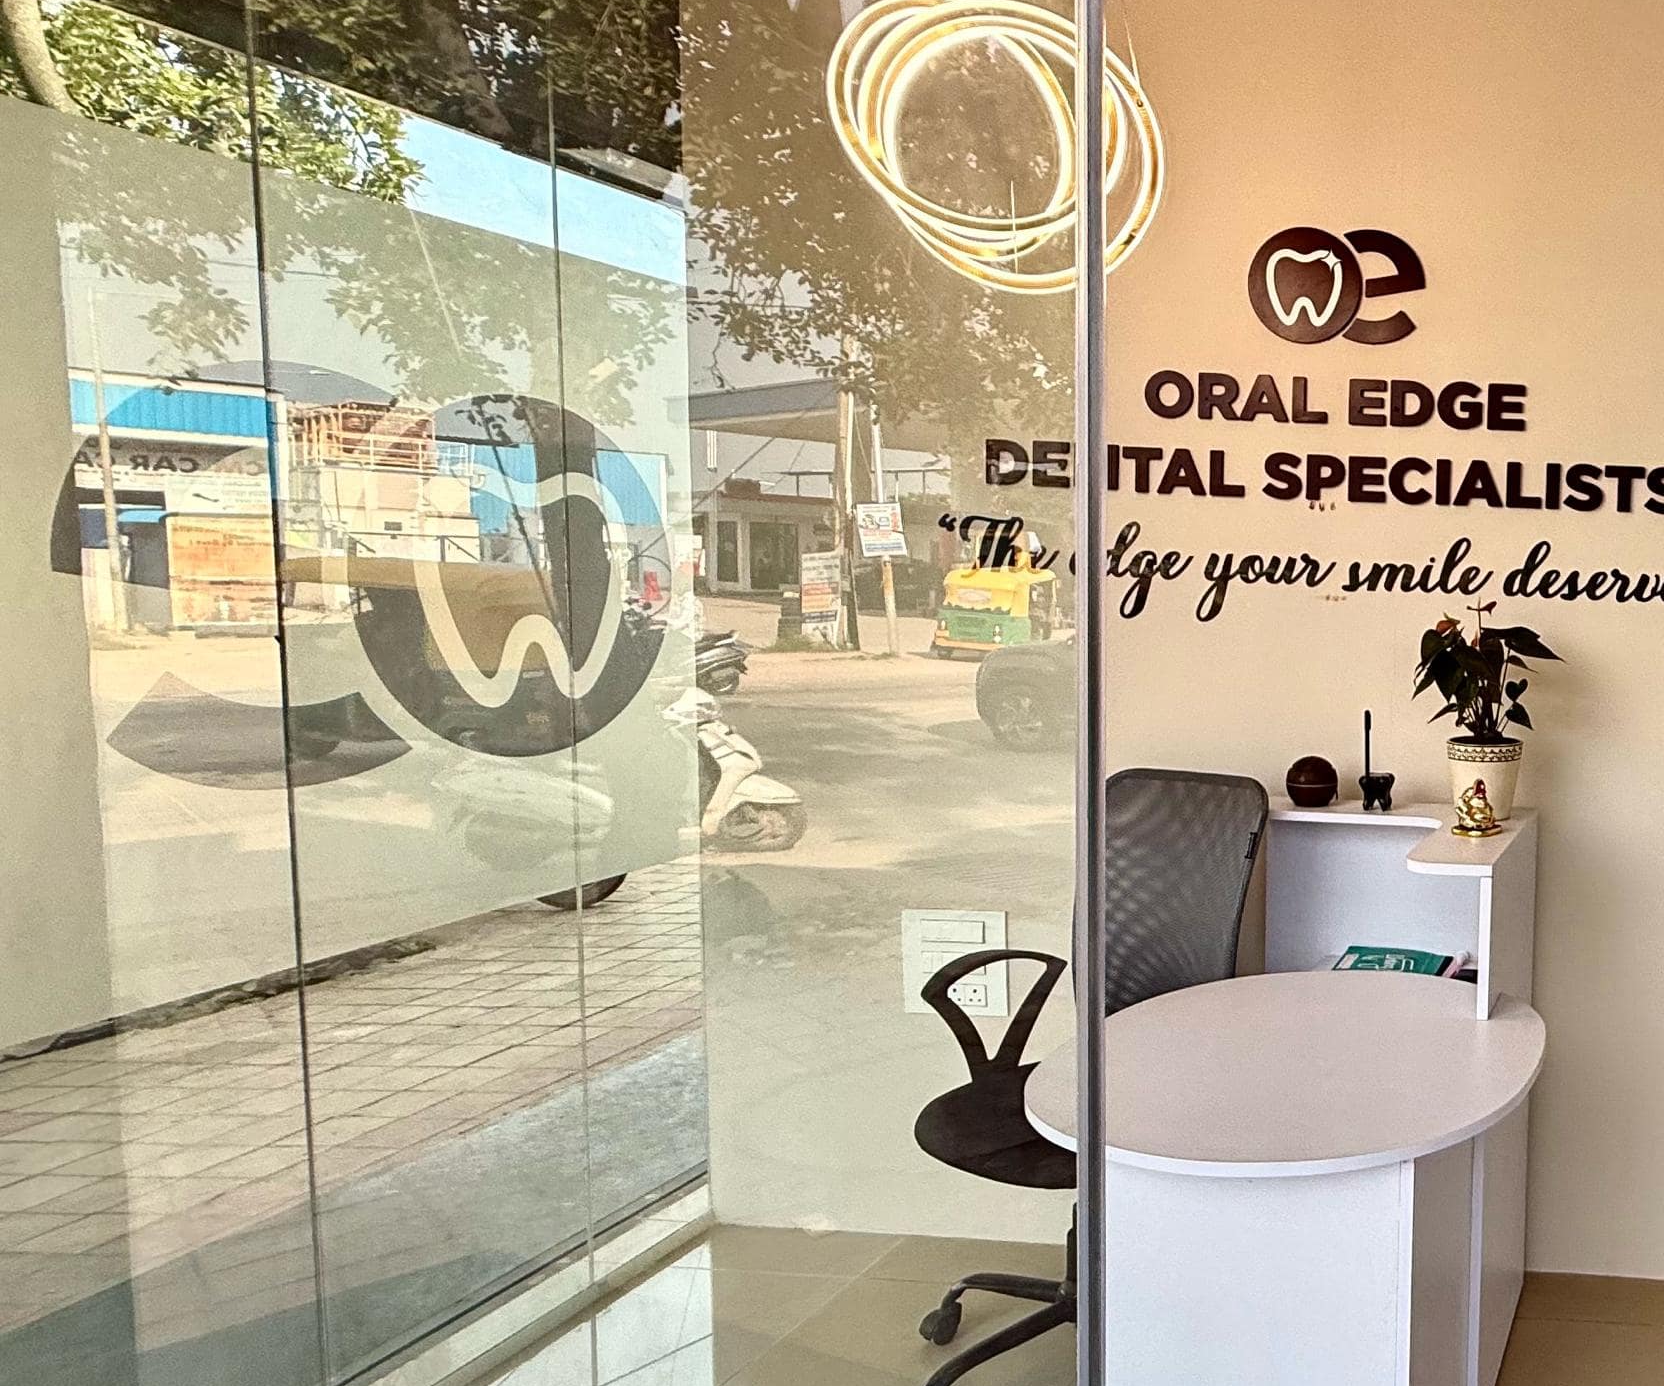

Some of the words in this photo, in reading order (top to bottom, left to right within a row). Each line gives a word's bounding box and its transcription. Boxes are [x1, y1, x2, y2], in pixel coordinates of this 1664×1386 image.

[1144, 370, 1329, 425] ORAL
[1348, 378, 1528, 432] EDGE
[1196, 553, 1337, 621] your
[1342, 537, 1494, 596] smile
